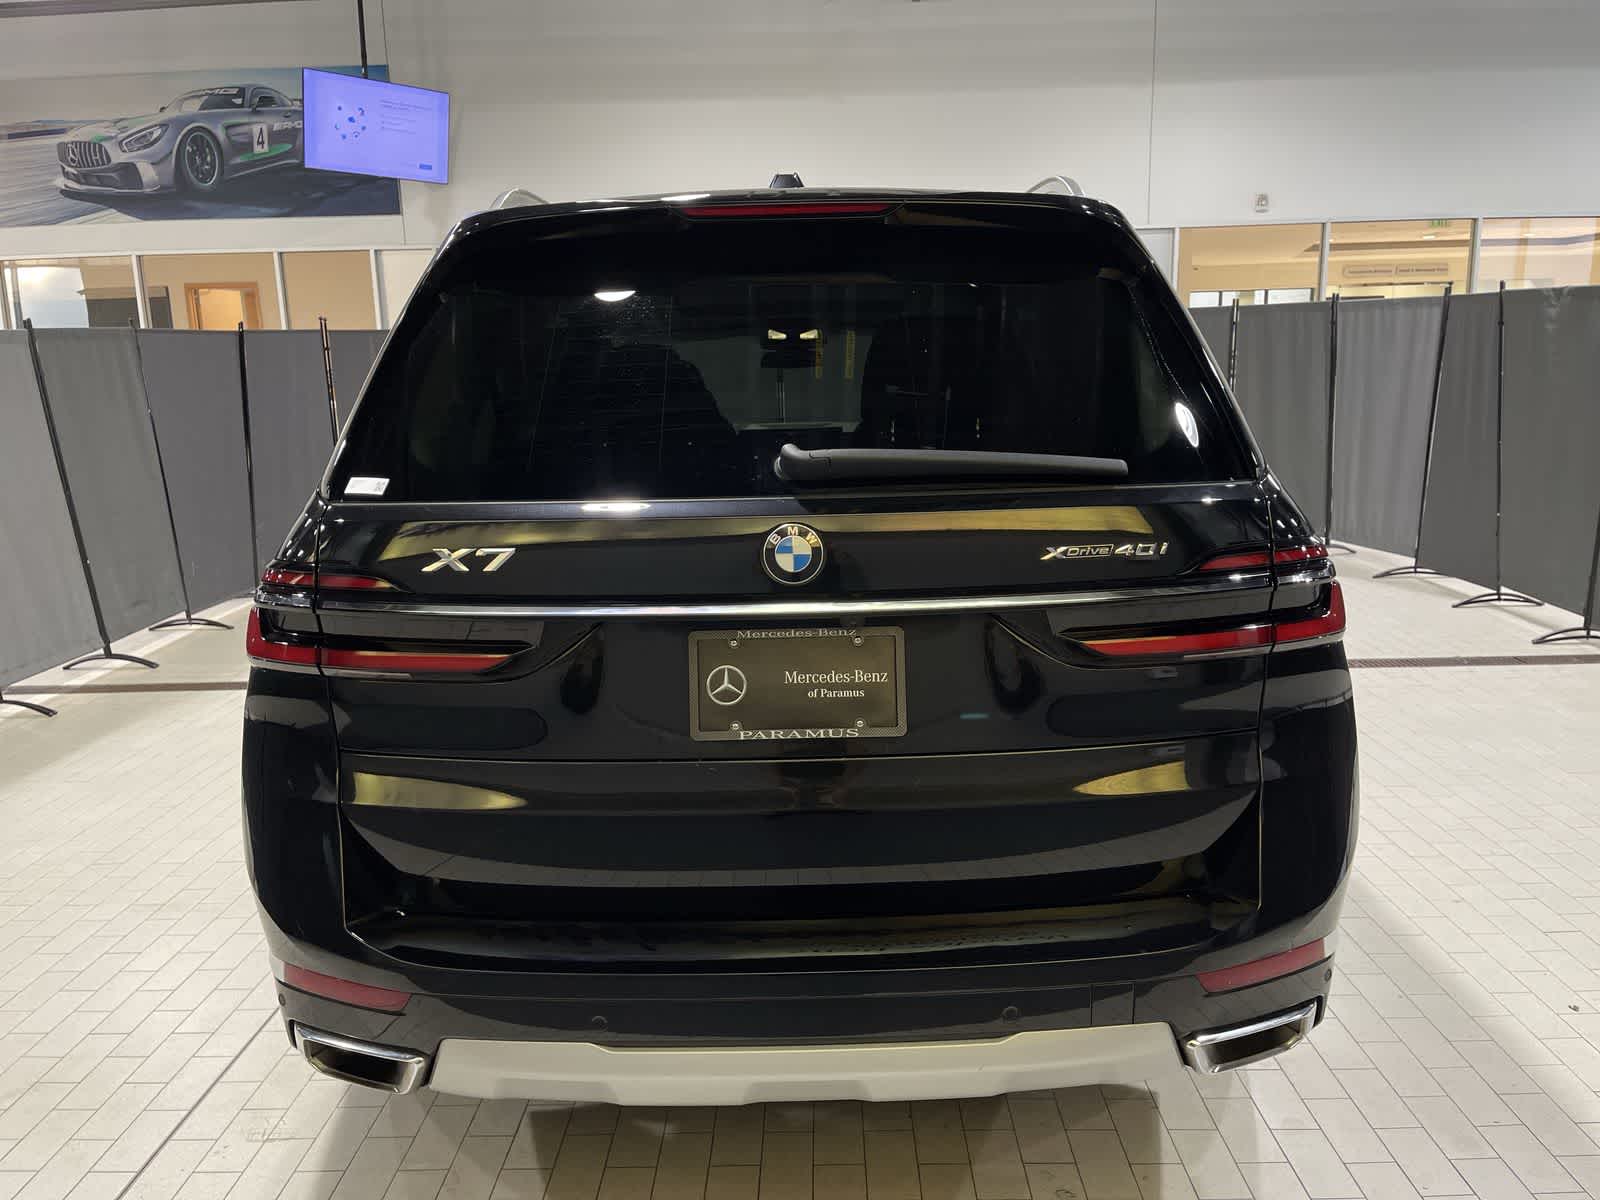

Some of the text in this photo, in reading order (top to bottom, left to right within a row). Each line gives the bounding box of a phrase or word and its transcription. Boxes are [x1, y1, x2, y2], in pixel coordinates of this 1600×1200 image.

[256, 127, 265, 150] 4
[769, 525, 818, 546] BMW
[420, 547, 517, 572] X7
[736, 628, 858, 639] Mercedes-Benz
[783, 669, 889, 684] Mercedes-Benz
[807, 688, 865, 698] of Paramus
[738, 728, 860, 740] PARAMUS
